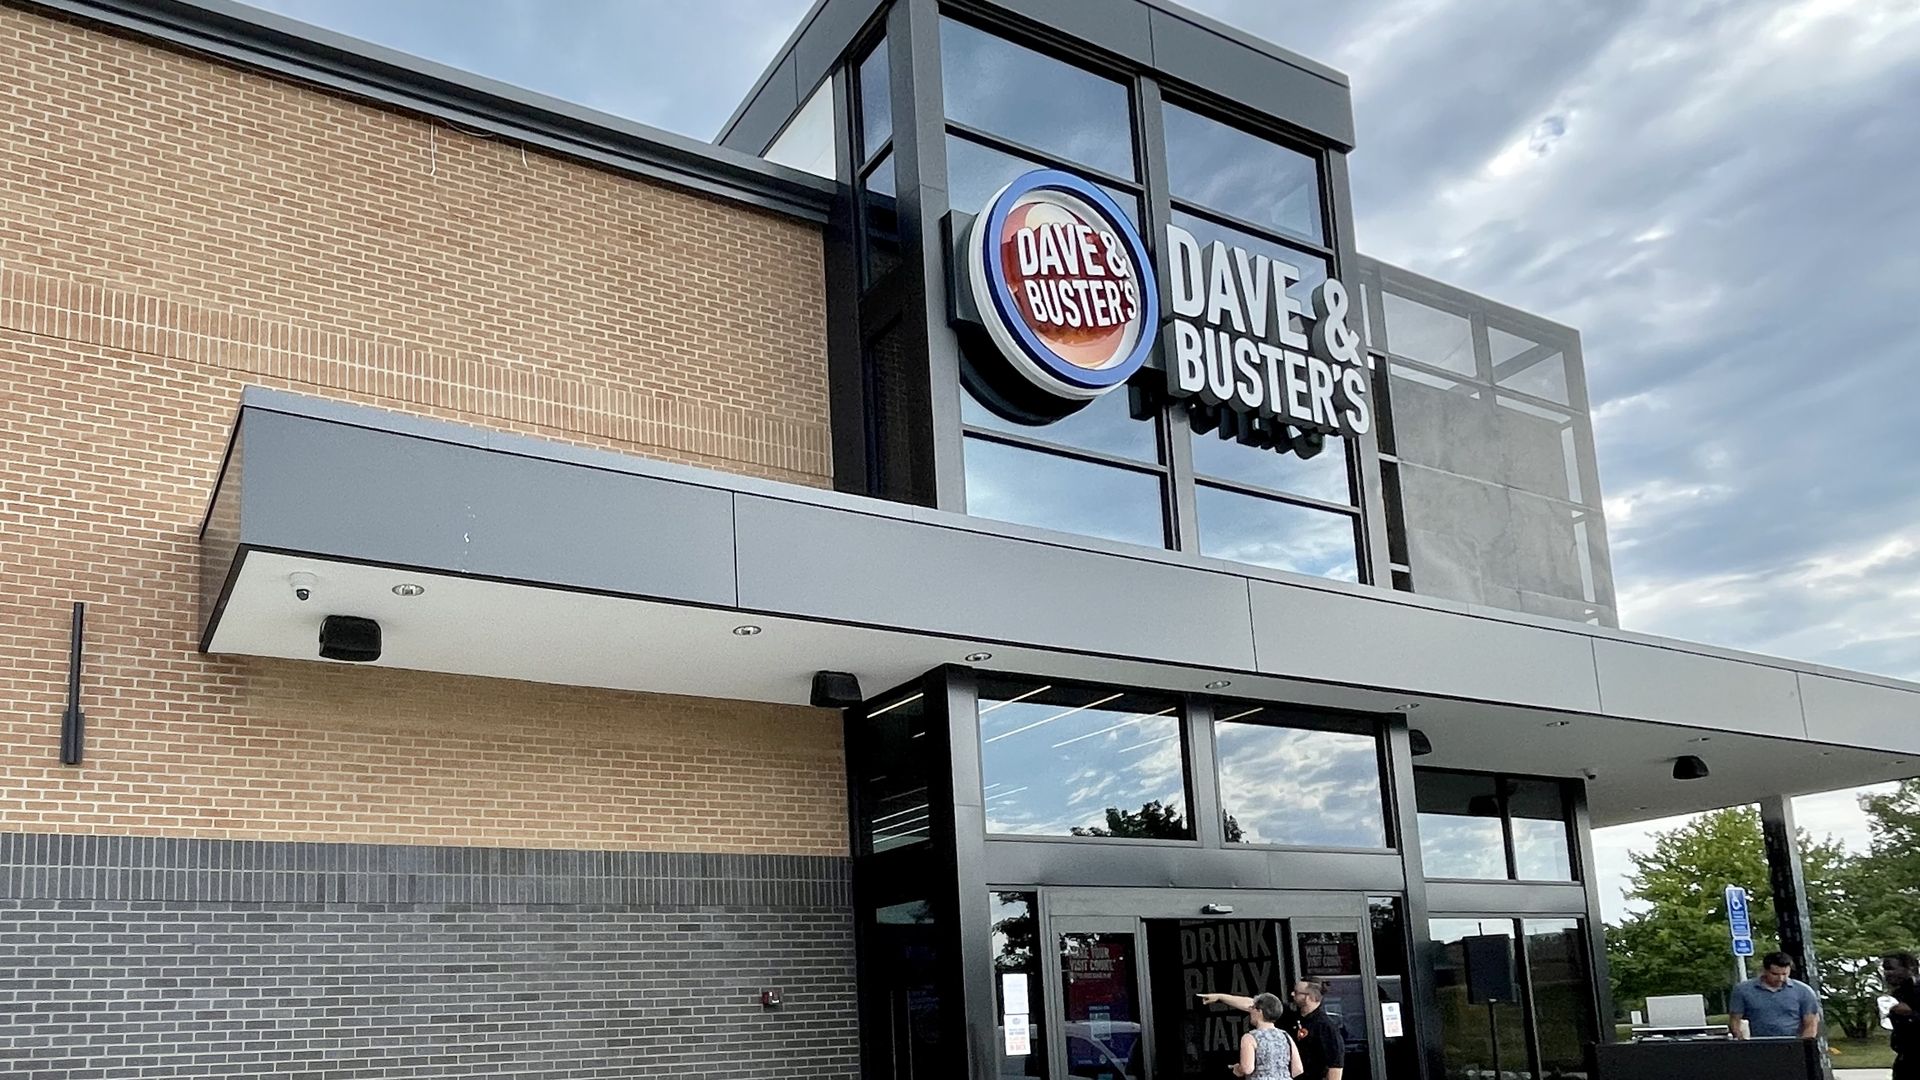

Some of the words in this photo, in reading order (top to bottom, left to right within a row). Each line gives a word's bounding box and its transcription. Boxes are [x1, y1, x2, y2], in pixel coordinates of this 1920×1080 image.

[1017, 223, 1106, 277] DAVE
[1099, 230, 1131, 279] &
[1024, 278, 1138, 328] BUSTER'S
[1166, 223, 1309, 351] DAVE
[1323, 277, 1363, 367] &
[1174, 318, 1370, 435] BUSTER'S
[1180, 919, 1272, 966] DRINK
[1183, 960, 1272, 1012] PLAY
